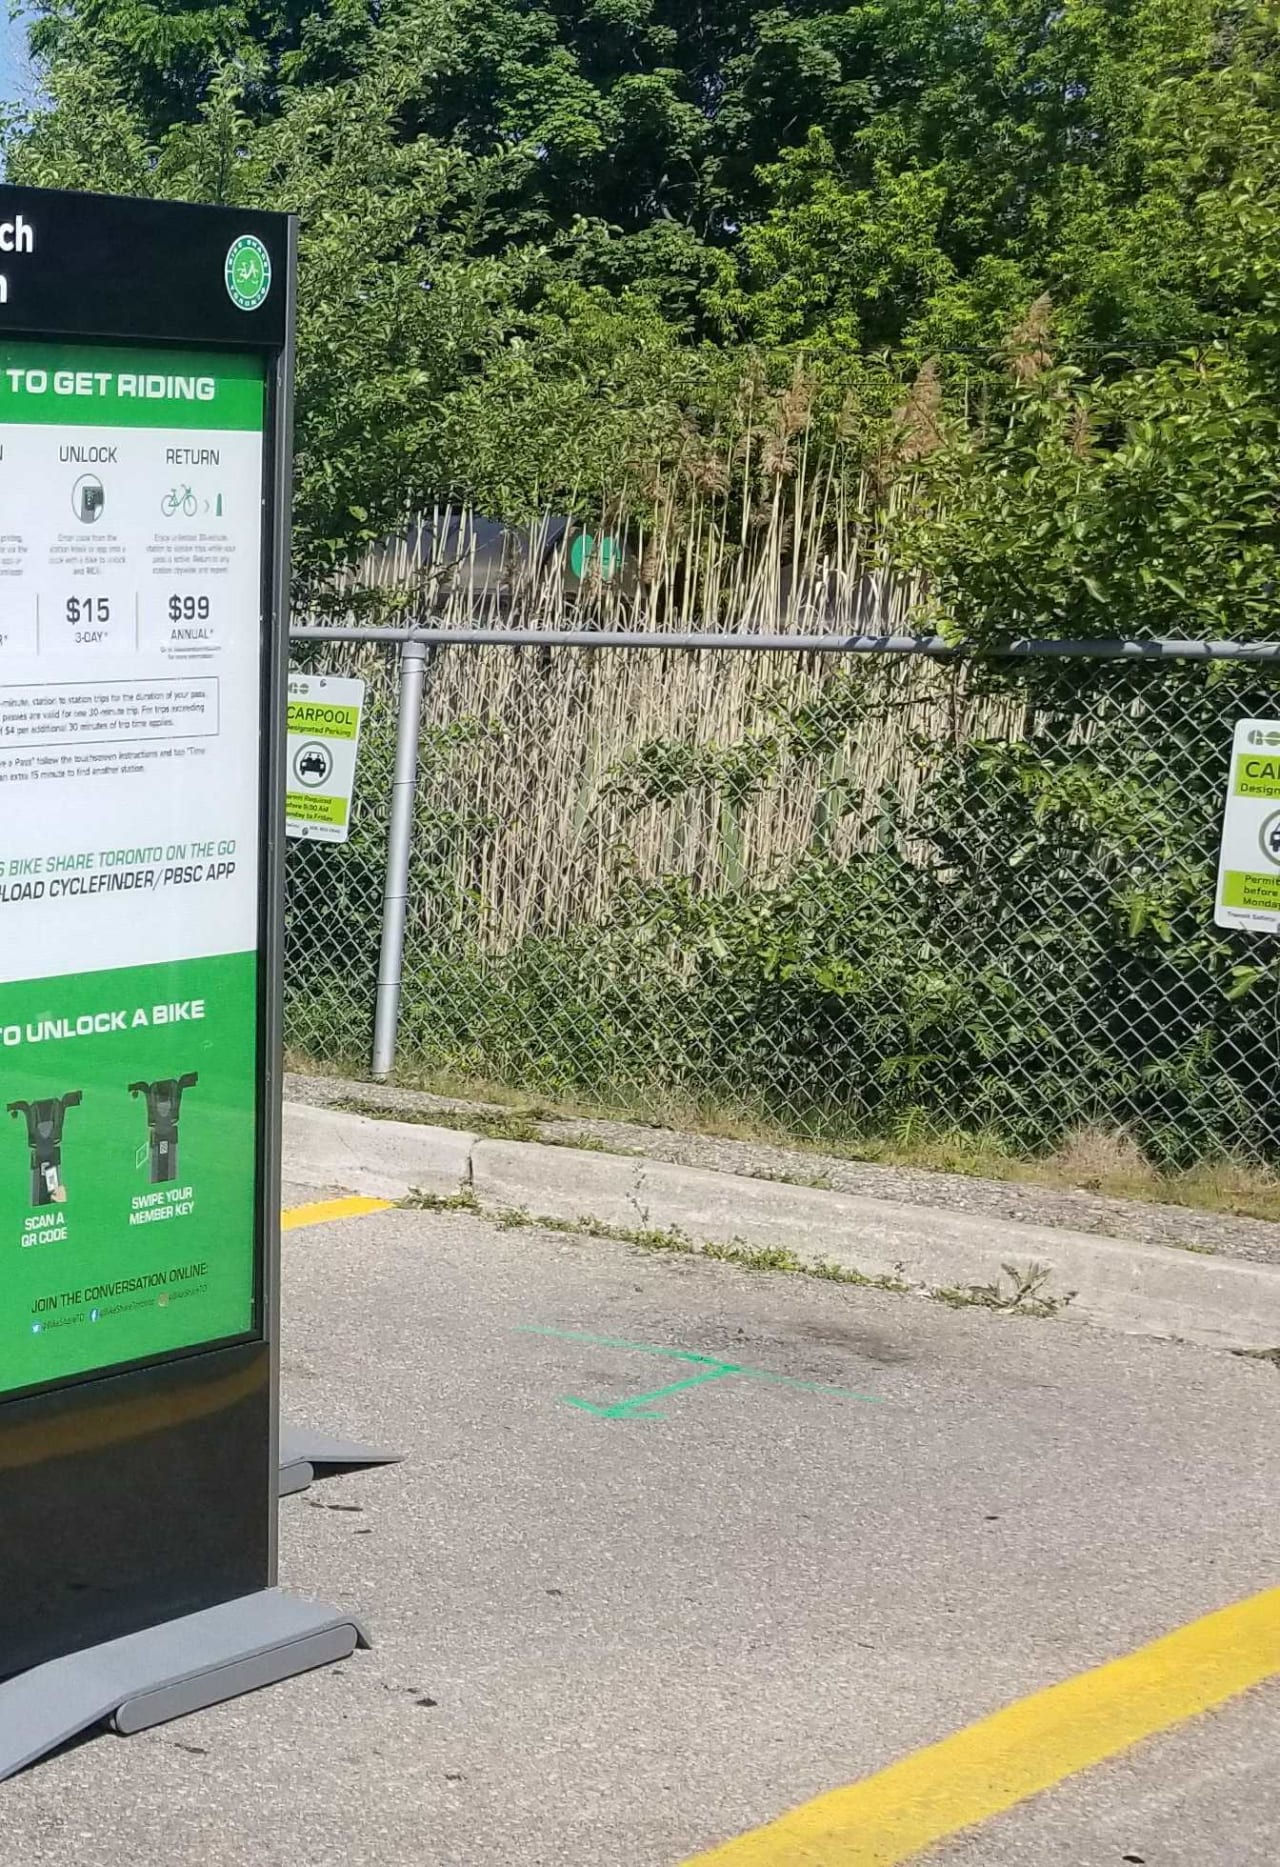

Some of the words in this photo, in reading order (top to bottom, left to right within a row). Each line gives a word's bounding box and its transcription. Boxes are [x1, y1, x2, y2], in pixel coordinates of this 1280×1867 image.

[7, 369, 47, 394] TO
[54, 372, 112, 396] GET
[117, 374, 215, 401] RIDING
[59, 446, 118, 463] UNLOCK
[166, 449, 220, 465] RETURN
[66, 596, 110, 625] $15
[168, 594, 209, 623] $99
[287, 706, 353, 725] CARPOOL
[1246, 762, 1280, 779] CA
[9, 857, 42, 877] BIKE
[45, 855, 94, 873] SHARE
[99, 847, 163, 868] TORONTO
[166, 846, 187, 860] ON
[191, 842, 215, 858] THE
[217, 840, 237, 855] GO
[206, 862, 236, 881] APP
[26, 1008, 127, 1043] UNLOCK
[130, 1008, 150, 1028] A
[151, 1000, 206, 1026] BIKE
[131, 1192, 165, 1210] SWIPE
[167, 1186, 193, 1205] YOUR
[24, 1213, 54, 1231] SCAN
[56, 1213, 65, 1226] A
[129, 1208, 173, 1226] MEMBER
[175, 1201, 194, 1217] KEY
[21, 1232, 39, 1248] QR
[40, 1227, 68, 1245] CODE
[32, 1296, 57, 1313] JOIN
[60, 1290, 81, 1307] THE
[84, 1272, 167, 1301] CONVERSATION
